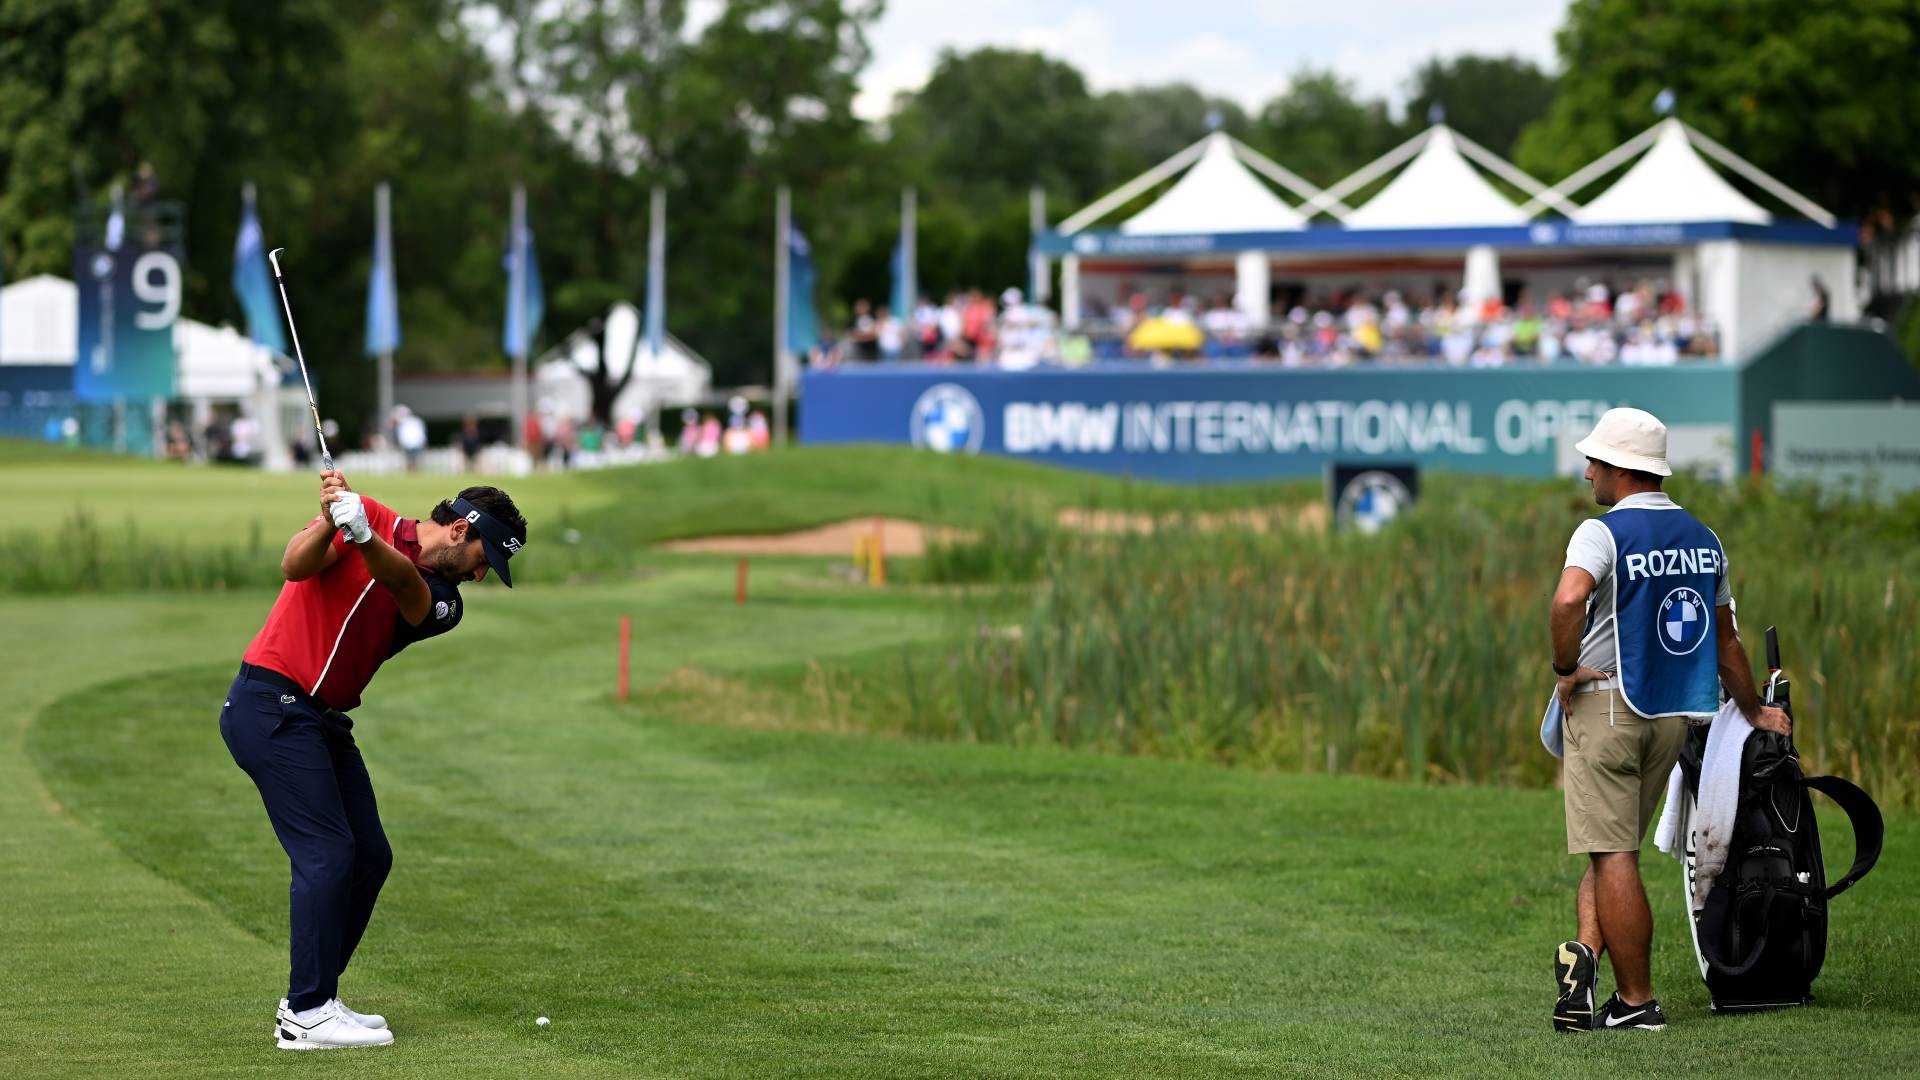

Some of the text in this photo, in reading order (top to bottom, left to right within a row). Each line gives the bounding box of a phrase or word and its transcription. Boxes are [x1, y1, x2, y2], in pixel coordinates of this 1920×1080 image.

[132, 251, 182, 331] 9
[1004, 399, 1612, 455] BMW INTERNATIONAL OPE
[465, 510, 481, 524] FJ
[1625, 548, 1721, 581] ROZNER
[1664, 591, 1701, 610] BMW
